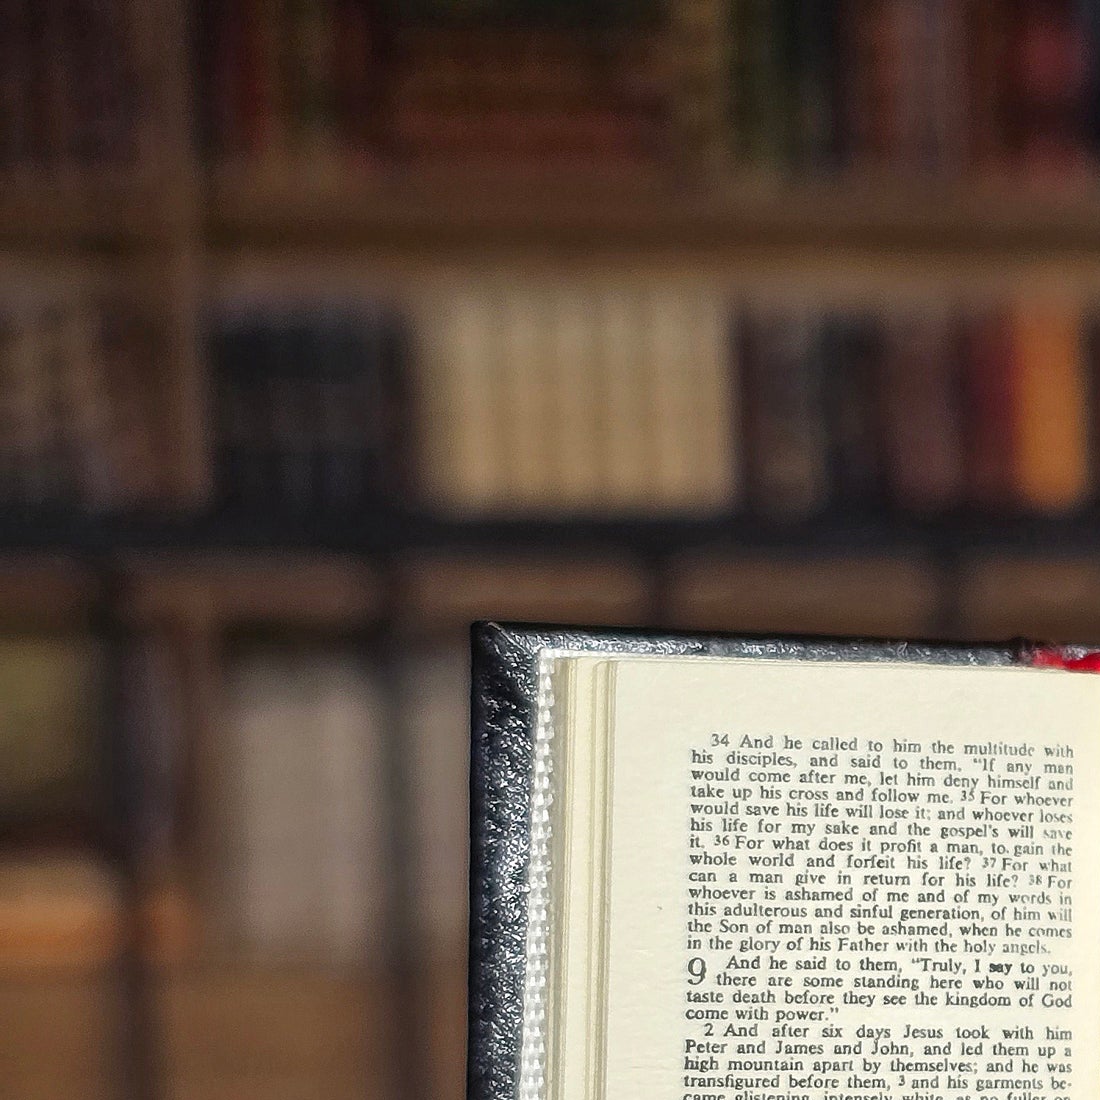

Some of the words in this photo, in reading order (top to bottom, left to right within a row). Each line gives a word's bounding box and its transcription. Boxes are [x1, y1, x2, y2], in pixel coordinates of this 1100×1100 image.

[711, 733, 730, 748] 34
[739, 734, 774, 749] And
[783, 735, 802, 750] he
[811, 736, 858, 751] called
[867, 739, 883, 752] to
[892, 738, 922, 753] him
[931, 739, 954, 754] the
[963, 740, 1035, 756] multitude
[1043, 743, 1074, 758] with
[687, 902, 717, 916] this
[723, 902, 808, 917] adulterous
[814, 903, 843, 918] and
[849, 904, 893, 919] sinful
[899, 905, 984, 923] generation,
[990, 906, 1007, 920] of
[1013, 906, 1041, 921] him
[1047, 907, 1072, 921] will
[715, 972, 757, 986] there
[767, 976, 793, 987] are
[802, 976, 844, 987] some
[853, 974, 920, 992] standing
[929, 975, 963, 989] here
[972, 975, 1004, 990] who
[1013, 976, 1040, 990] will
[1049, 978, 1072, 990] not
[686, 990, 724, 1003] taste
[731, 989, 776, 1004] death
[784, 990, 835, 1004] before
[842, 990, 876, 1008] they
[882, 994, 907, 1005] see
[914, 991, 938, 1006] the
[945, 992, 1012, 1010] kingdom
[1018, 993, 1034, 1007] of
[1041, 993, 1072, 1007] God
[684, 1010, 729, 1020] come
[734, 1006, 769, 1020] with
[703, 1022, 714, 1036] 2
[722, 1022, 758, 1037] And
[771, 1023, 810, 1037] after
[821, 1024, 843, 1038] six
[855, 1024, 891, 1042] days
[902, 1024, 944, 1039] Jesus
[955, 1025, 990, 1039] took
[1001, 1026, 1034, 1040] with
[1045, 1026, 1072, 1040] him
[683, 1056, 719, 1074] high
[726, 1056, 804, 1071] mountain
[812, 1058, 854, 1075] apart
[862, 1057, 882, 1075] by
[889, 1057, 978, 1074] themselves;
[985, 1058, 1013, 1072] and
[1021, 1058, 1039, 1072] he
[1046, 1062, 1072, 1073] was
